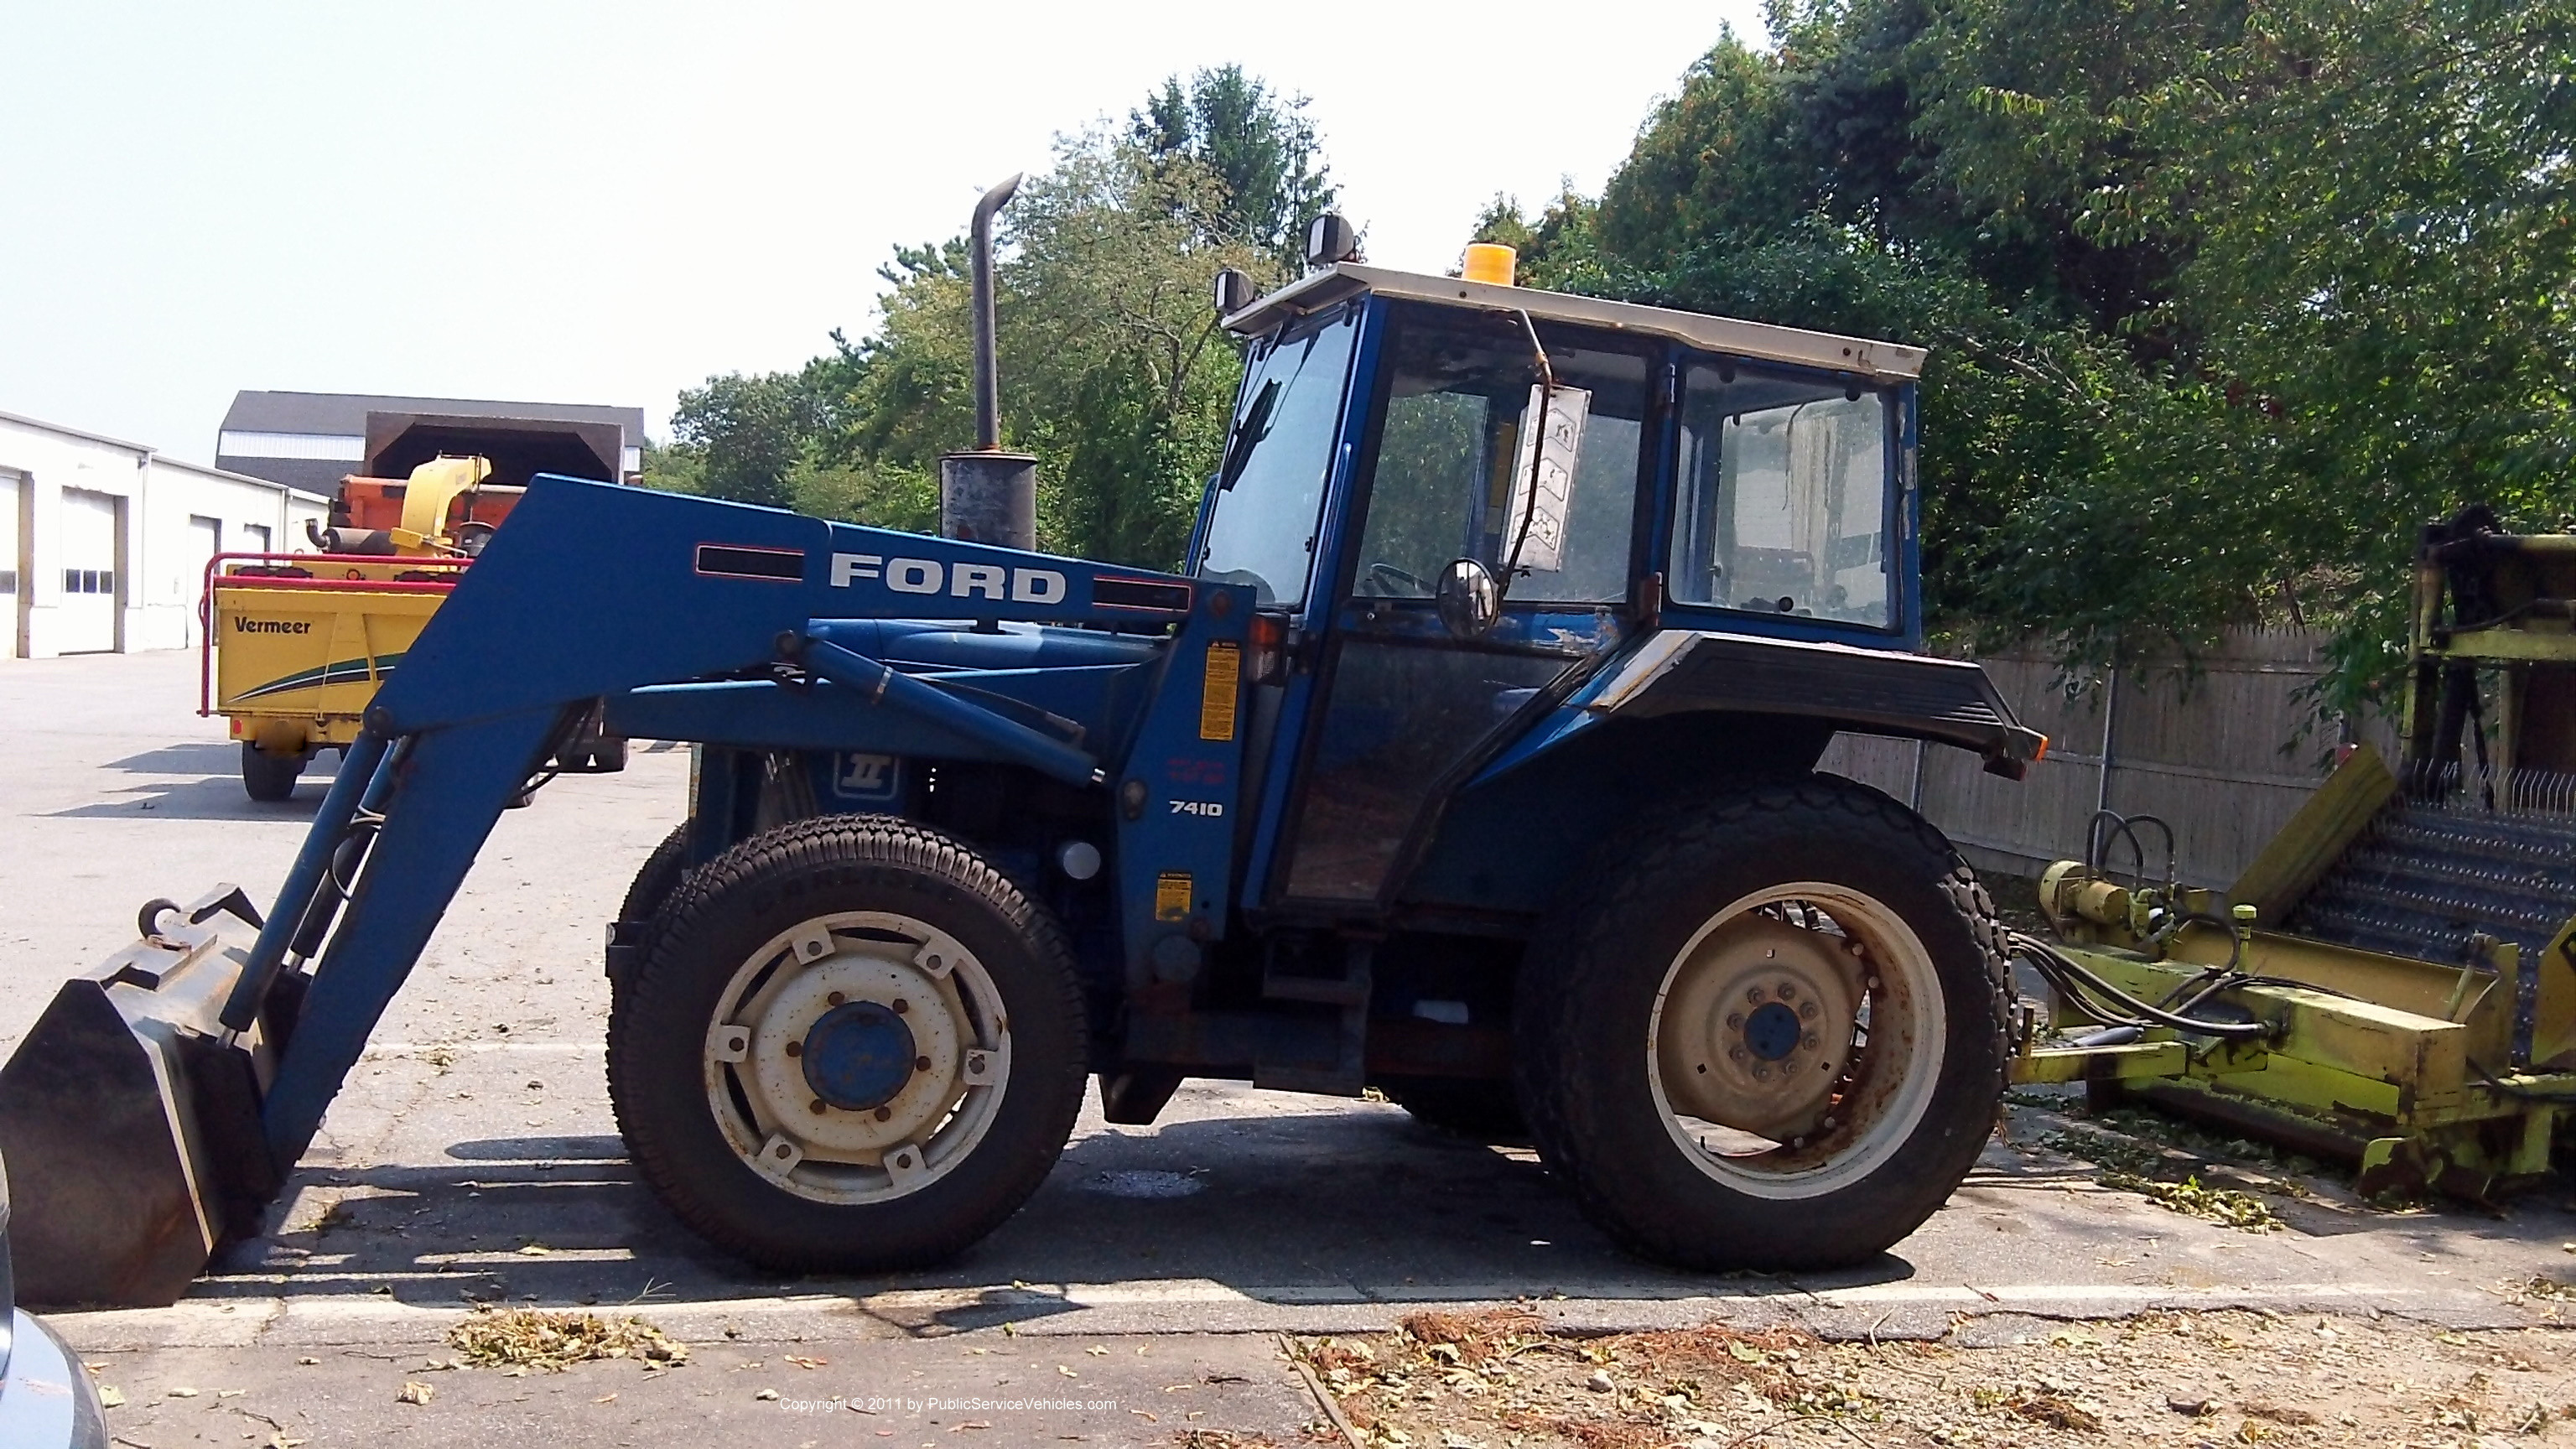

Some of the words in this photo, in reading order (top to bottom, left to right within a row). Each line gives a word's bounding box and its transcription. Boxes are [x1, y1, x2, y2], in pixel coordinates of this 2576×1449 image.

[829, 552, 1067, 605] FORD
[234, 616, 311, 634] Vermeer
[1168, 800, 1223, 817] 7410
